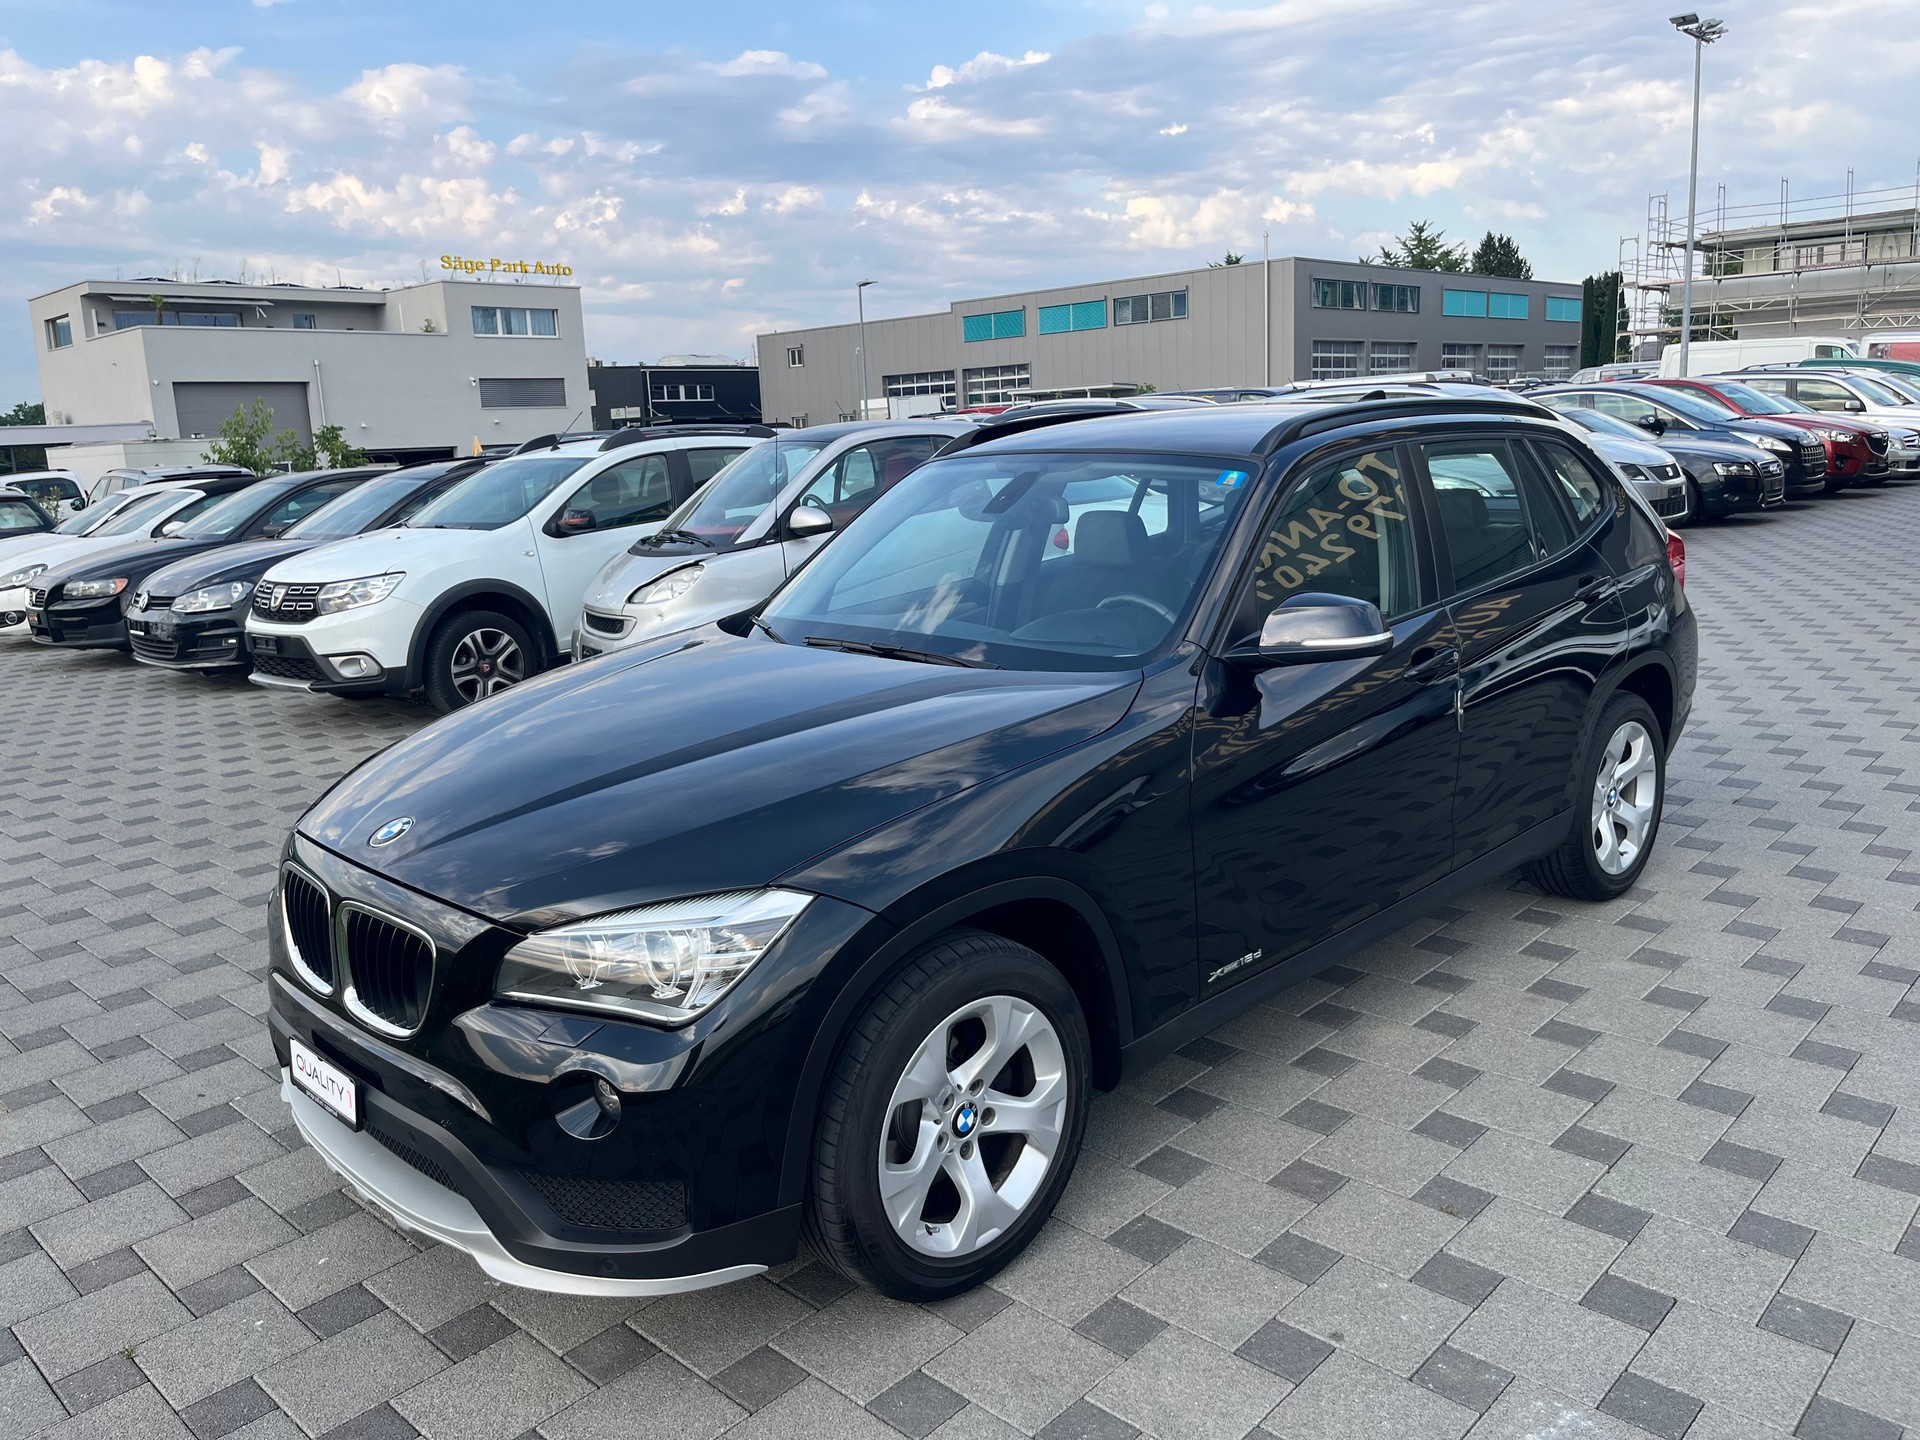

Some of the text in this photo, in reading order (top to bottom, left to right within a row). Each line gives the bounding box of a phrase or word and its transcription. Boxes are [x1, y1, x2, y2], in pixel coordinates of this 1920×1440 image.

[440, 254, 573, 276] Säge Park Auto
